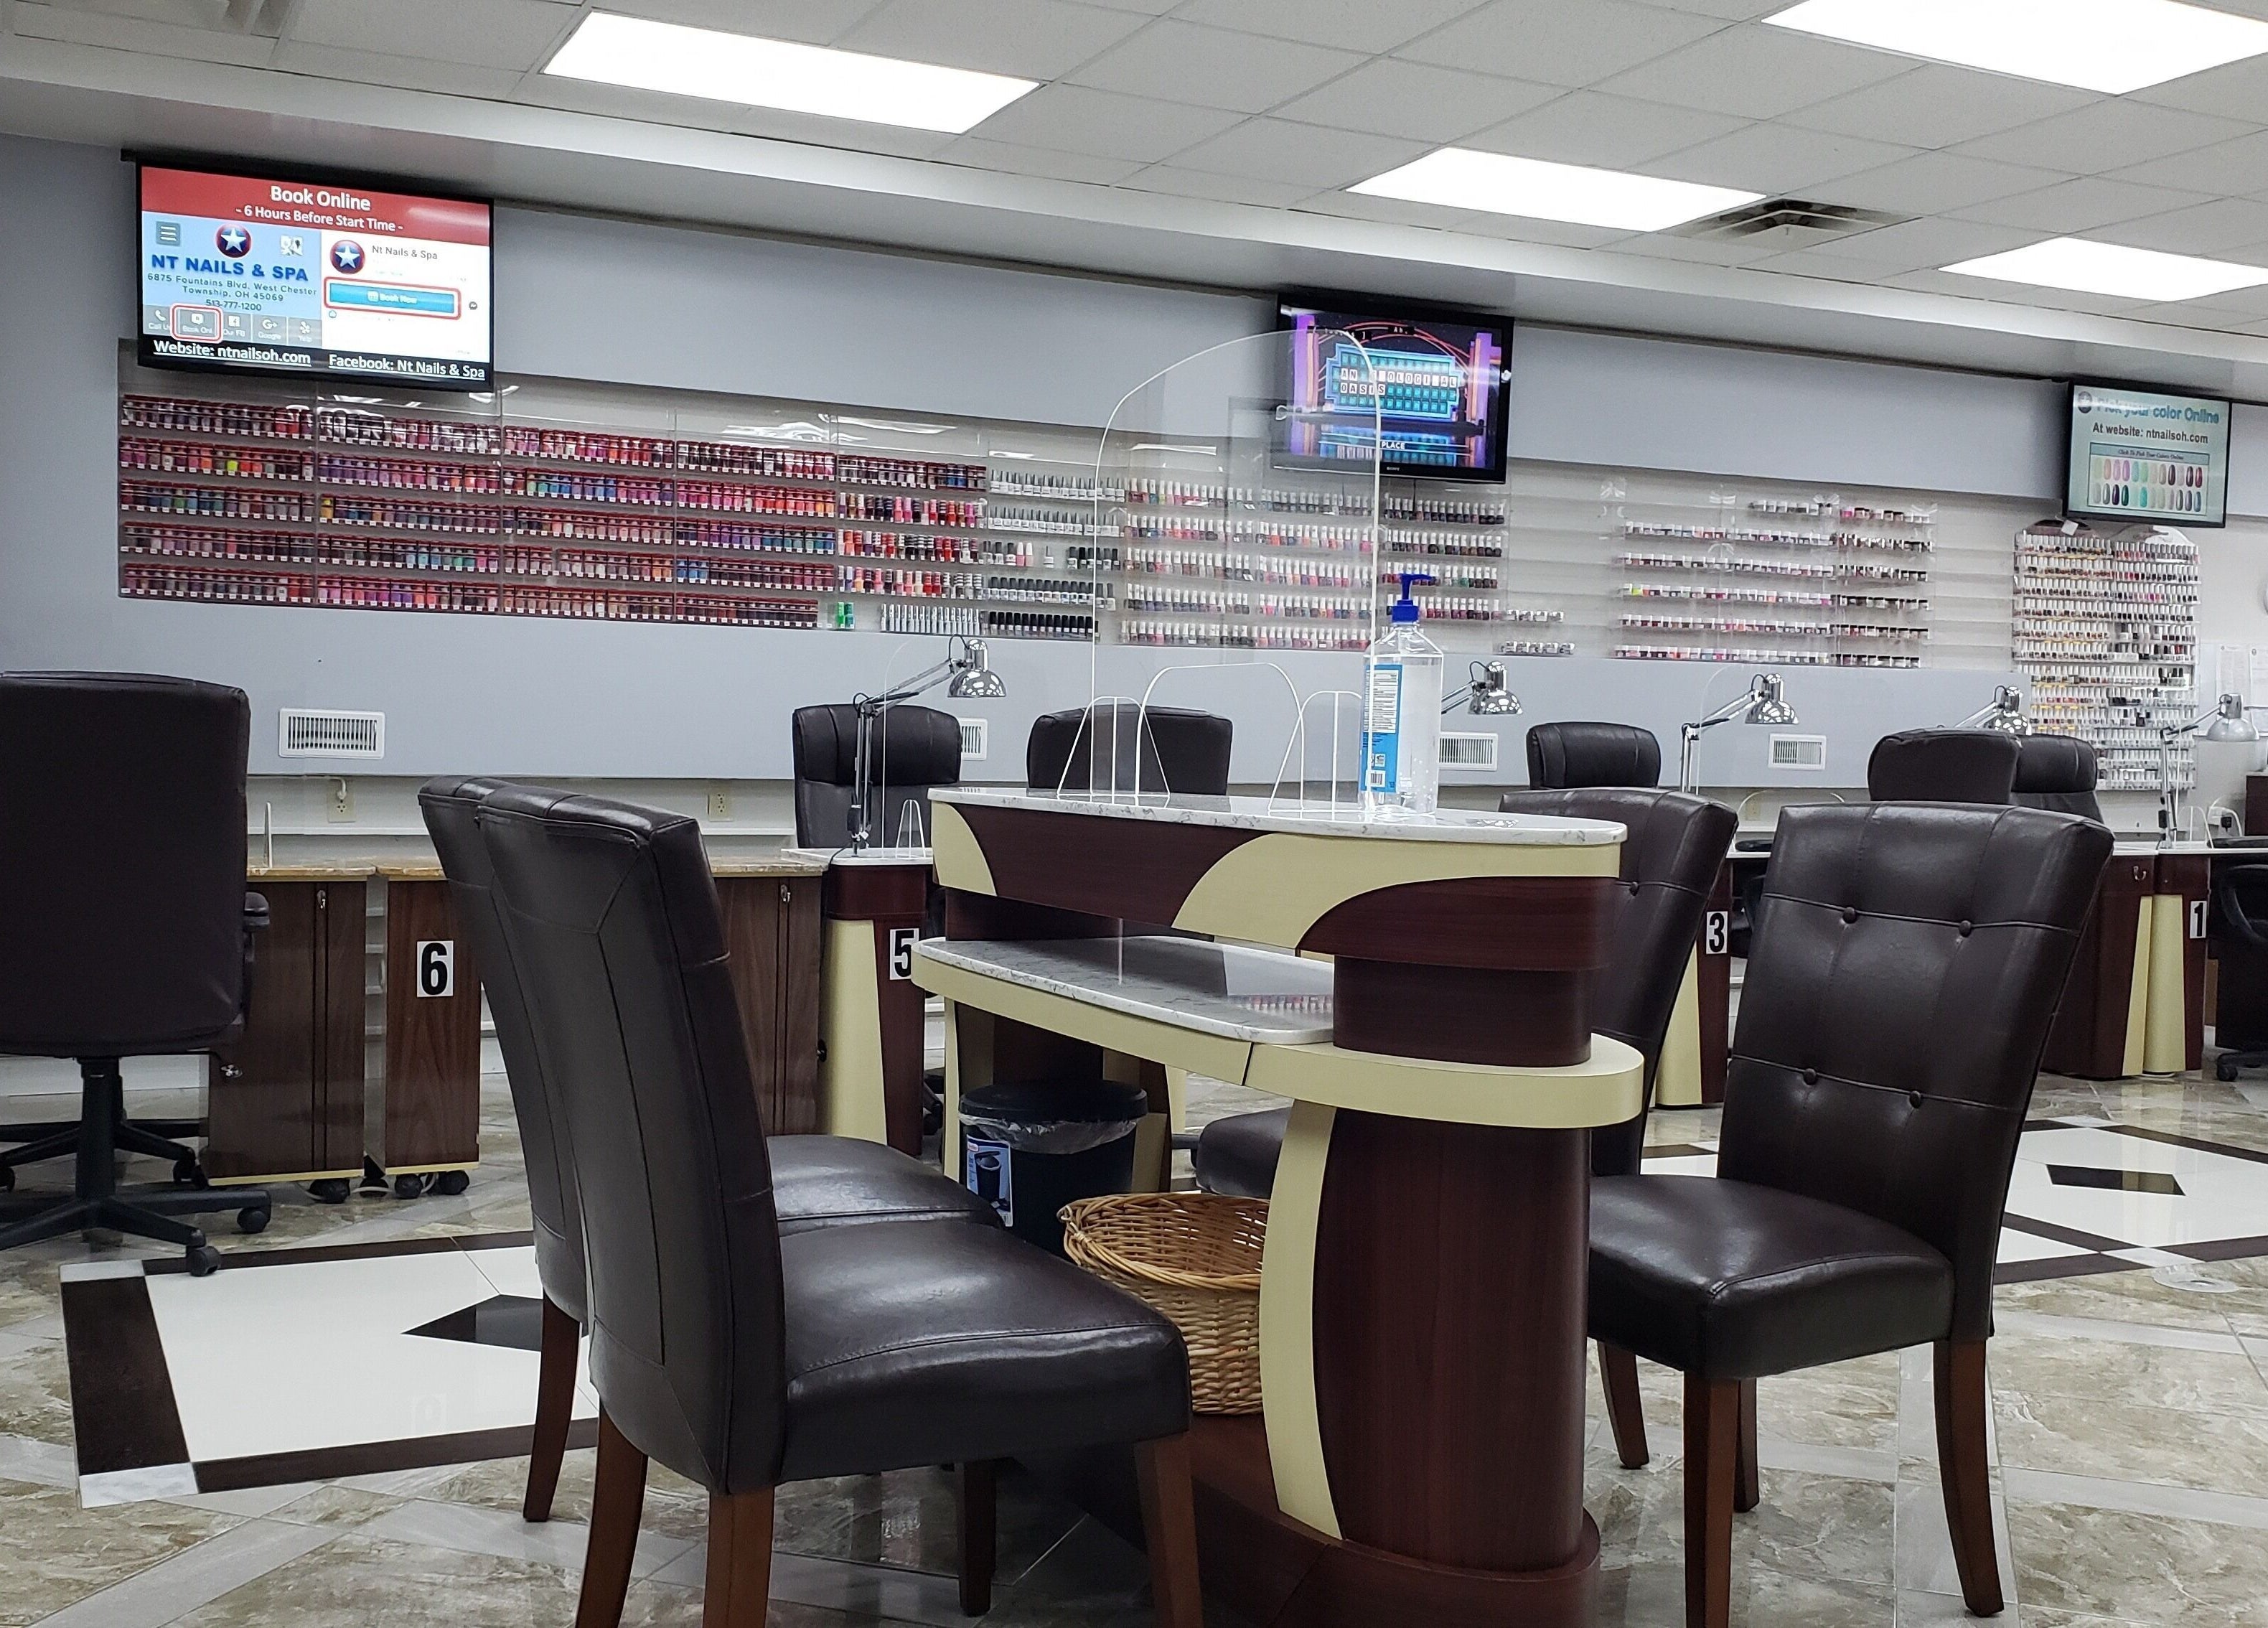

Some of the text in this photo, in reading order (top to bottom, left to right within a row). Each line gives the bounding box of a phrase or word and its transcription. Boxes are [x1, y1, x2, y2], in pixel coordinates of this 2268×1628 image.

[271, 185, 371, 211] Book Online
[244, 205, 253, 216] 6
[255, 206, 291, 220] Hours
[294, 210, 334, 225] Before
[335, 215, 365, 229] Start
[366, 217, 396, 232] Time
[372, 245, 383, 254] Nt
[385, 246, 408, 257] Nails
[421, 250, 438, 261] Spa
[151, 254, 309, 281] NT NAILS & SPA
[147, 273, 317, 296] 6875 Fountains Blvd. West Chester
[205, 299, 262, 312] 513-777-1200
[253, 291, 284, 302] 45069
[154, 340, 311, 364] Website: ntnailsoh.com
[329, 354, 485, 379] Facebook: Nt Nails & Spa
[1341, 369, 1456, 385] AN OLOGIAL
[1341, 383, 1384, 394] OASIS
[2153, 406, 2182, 419] color
[2184, 408, 2219, 424] Online
[2092, 422, 2208, 444] At website: ntnailsoh.com
[1381, 441, 1405, 450] PLACE
[2194, 902, 2203, 937] 1
[1709, 912, 1725, 953] 3
[894, 930, 914, 977] 5
[421, 942, 448, 995] 6
